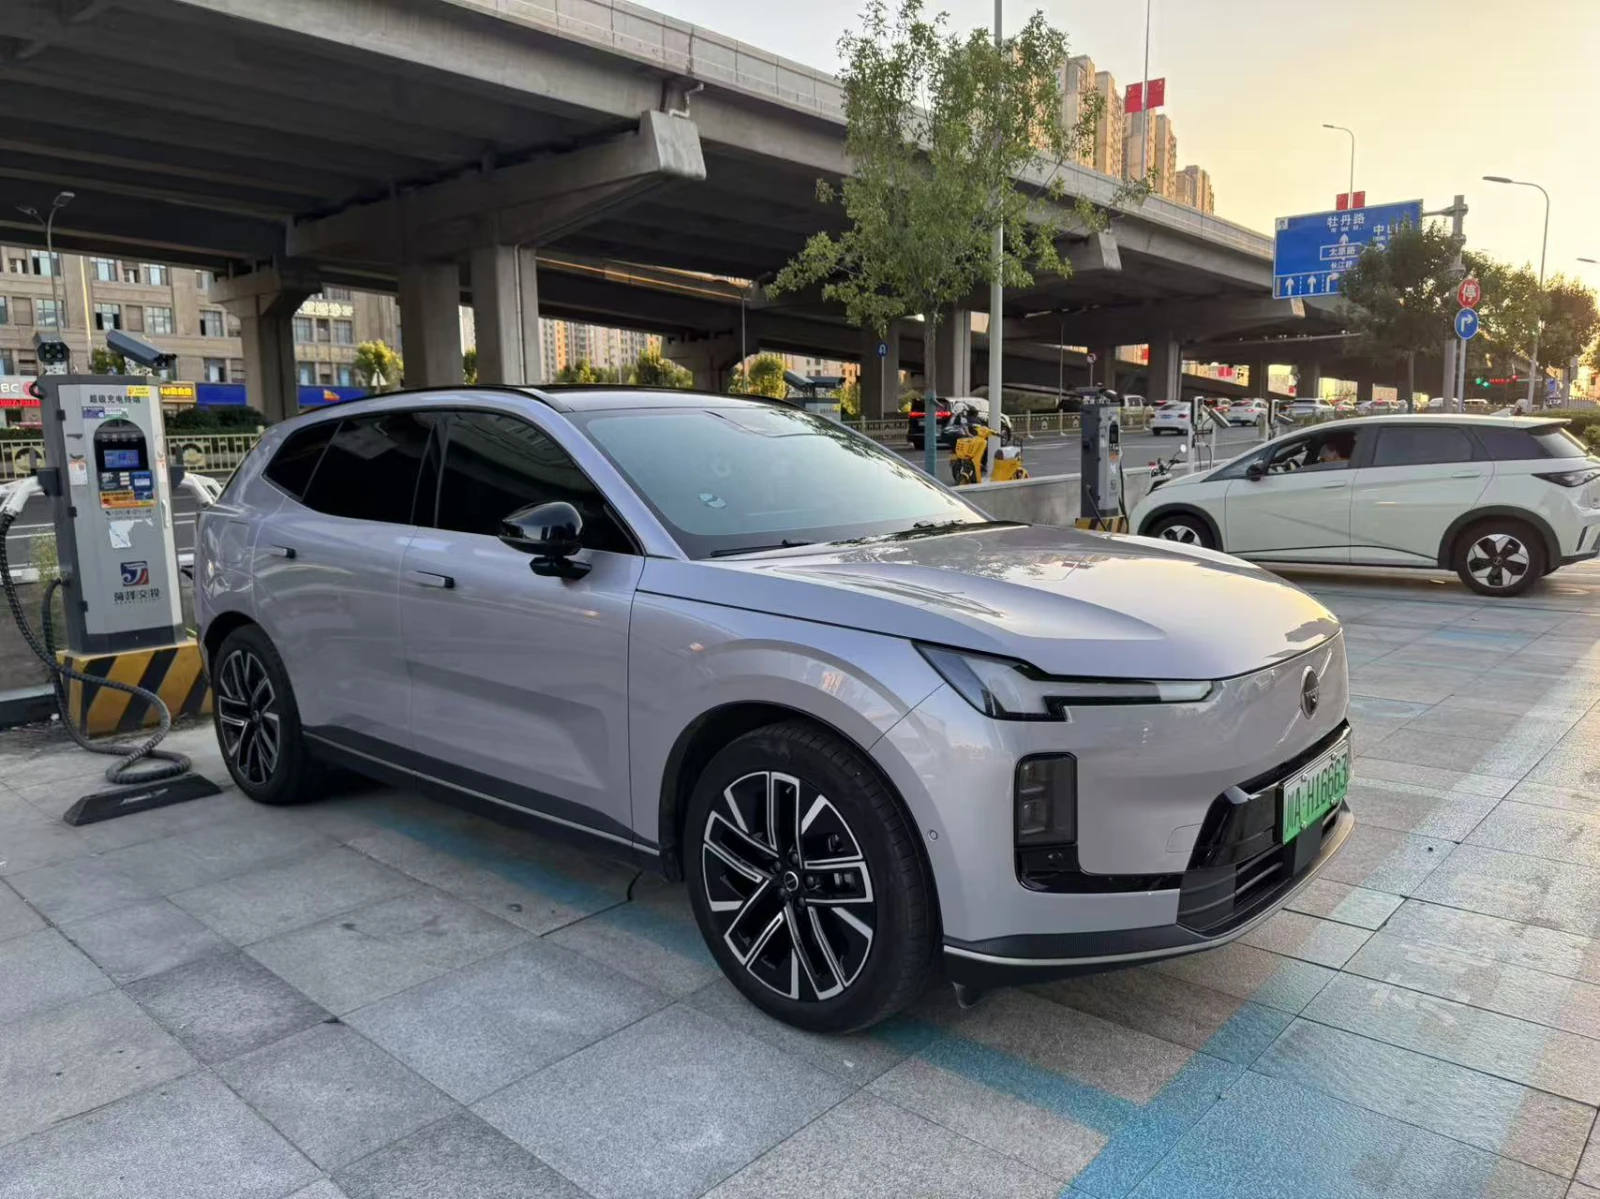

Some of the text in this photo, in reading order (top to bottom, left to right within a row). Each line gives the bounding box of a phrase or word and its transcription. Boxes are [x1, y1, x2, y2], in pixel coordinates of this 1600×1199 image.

[1326, 212, 1366, 229] 牡丹路
[1329, 246, 1356, 257] 太原路
[1462, 284, 1477, 303] 停
[89, 393, 142, 405] 超级充电终端
